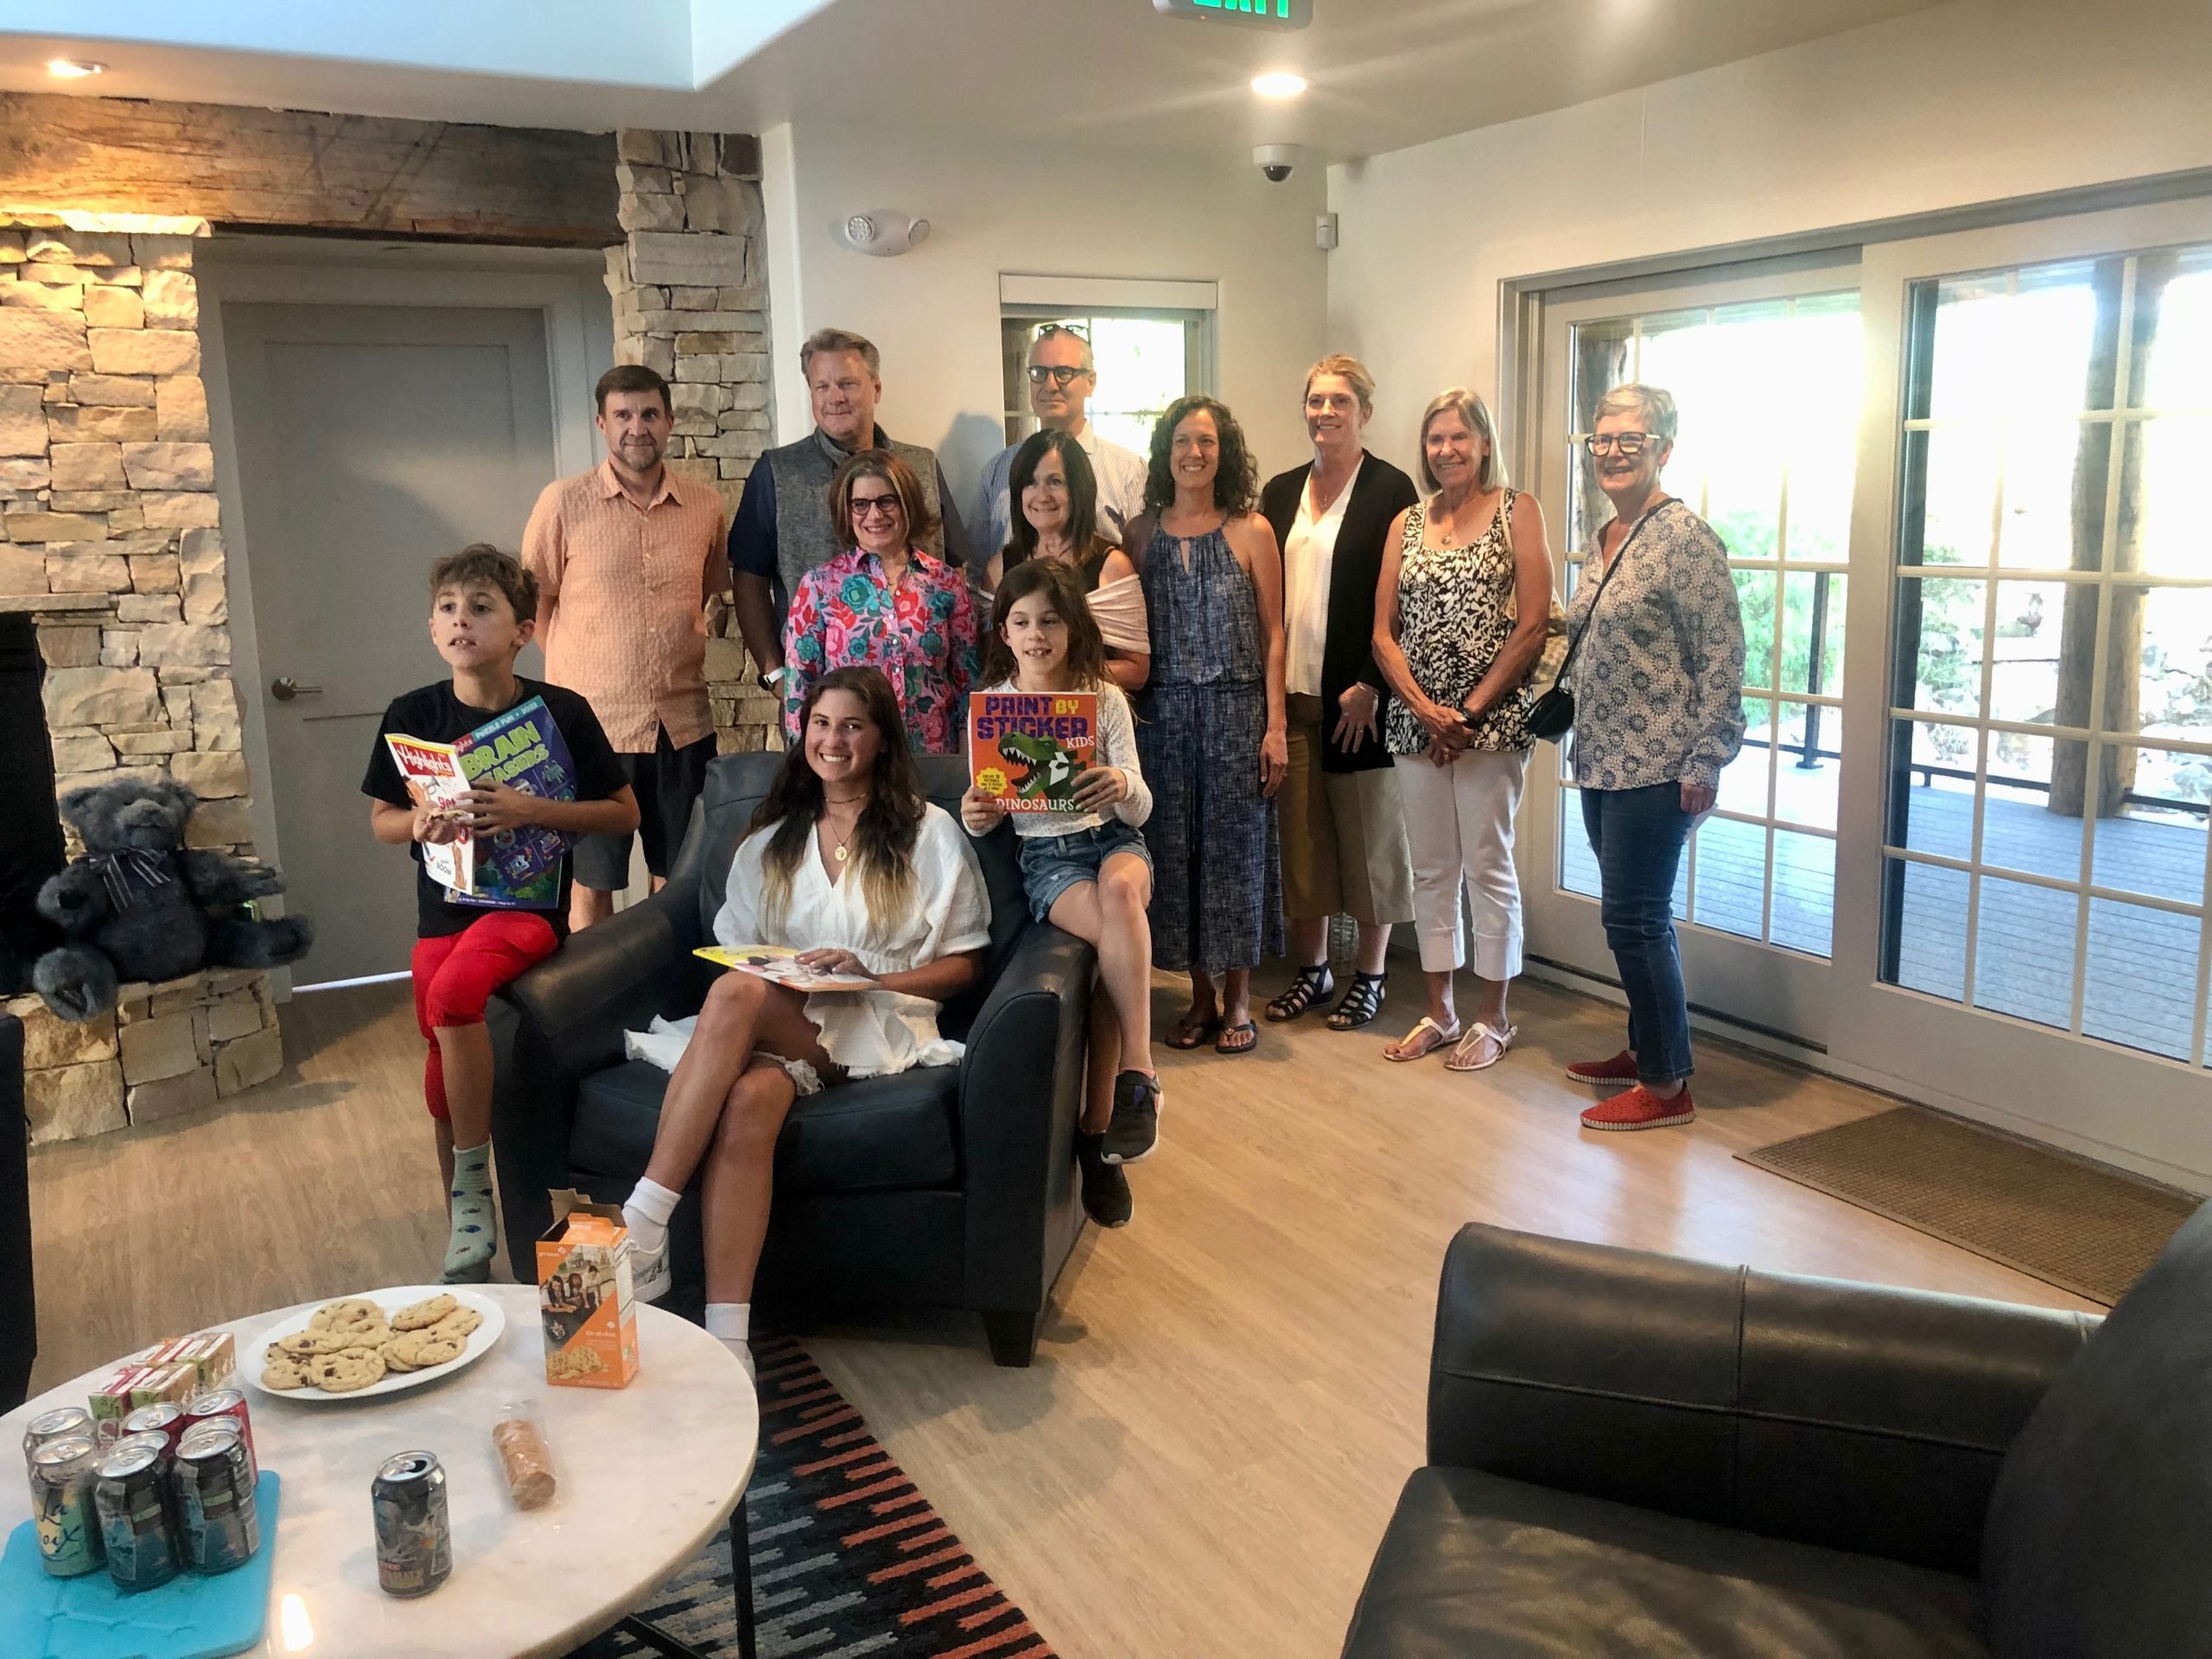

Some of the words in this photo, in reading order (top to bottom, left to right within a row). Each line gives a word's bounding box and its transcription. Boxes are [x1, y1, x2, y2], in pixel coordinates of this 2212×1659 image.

[985, 696, 1053, 715] PAINT
[1055, 699, 1079, 715] BY
[976, 716, 1089, 741] STICKER
[459, 721, 542, 781] BRAIN
[1065, 735, 1095, 749] KIDS
[397, 744, 453, 775] Highlights
[995, 798, 1076, 810] DINOSAURS
